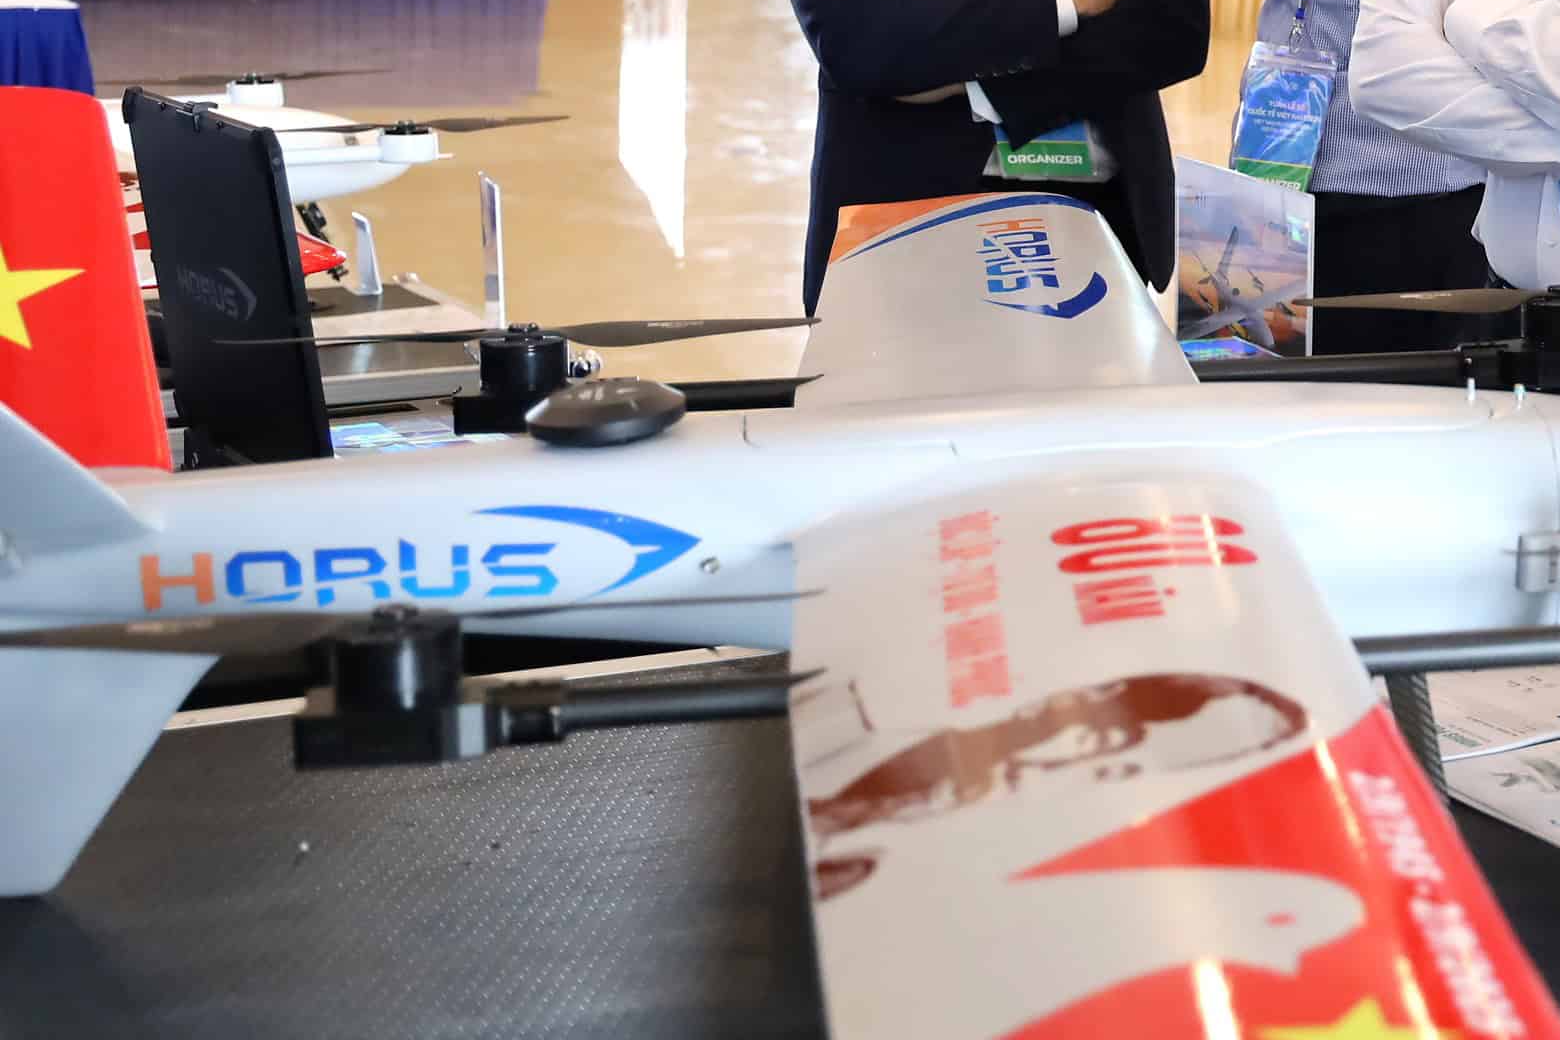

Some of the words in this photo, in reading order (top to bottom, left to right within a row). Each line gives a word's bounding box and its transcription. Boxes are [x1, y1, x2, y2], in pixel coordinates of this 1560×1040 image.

[1007, 153, 1083, 166] ORGANIZER
[976, 218, 1060, 294] HORUS
[139, 537, 560, 612] HORUS
